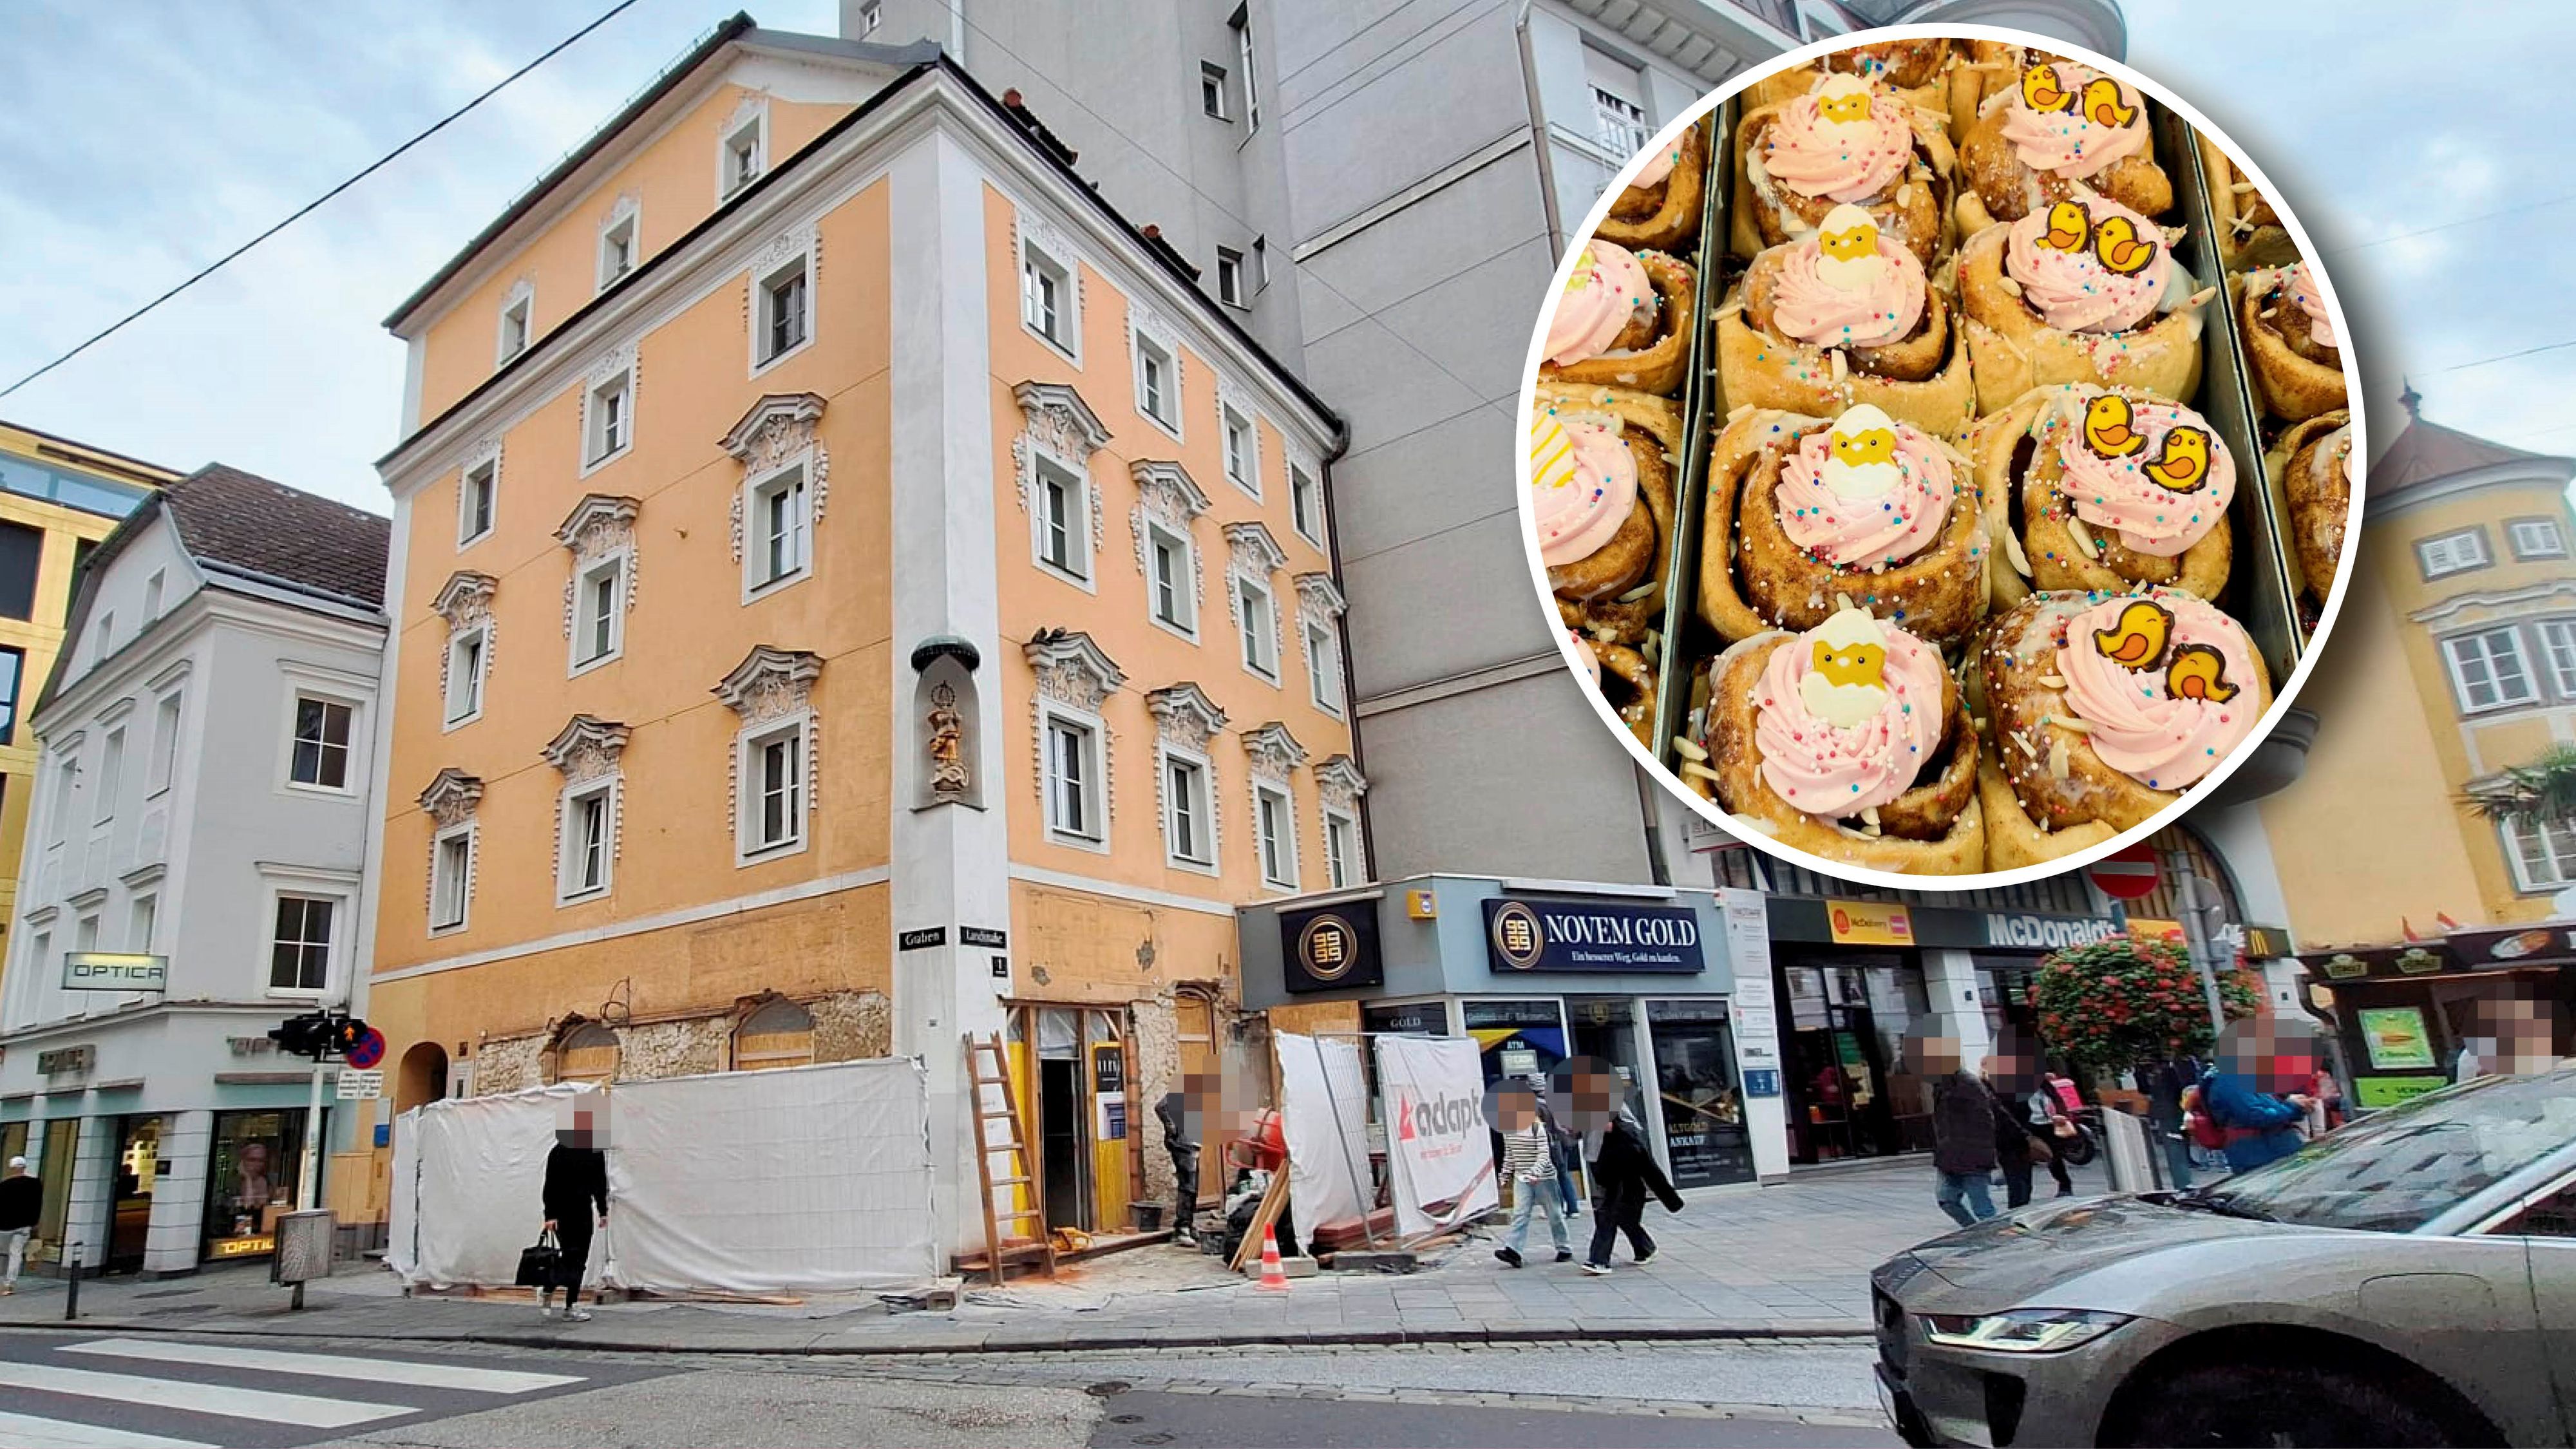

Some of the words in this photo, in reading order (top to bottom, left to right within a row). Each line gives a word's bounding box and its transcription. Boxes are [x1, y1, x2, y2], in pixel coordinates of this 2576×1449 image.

[1546, 914, 1633, 945] NOVEM
[1636, 918, 1696, 946] GOLD
[1987, 913, 2116, 947] McDonald's
[905, 932, 940, 945] Graben
[74, 965, 164, 979] OPTICA
[1390, 1016, 1421, 1027] GOLD
[1507, 1040, 1525, 1050] ATM
[1416, 1088, 1482, 1139] adapt
